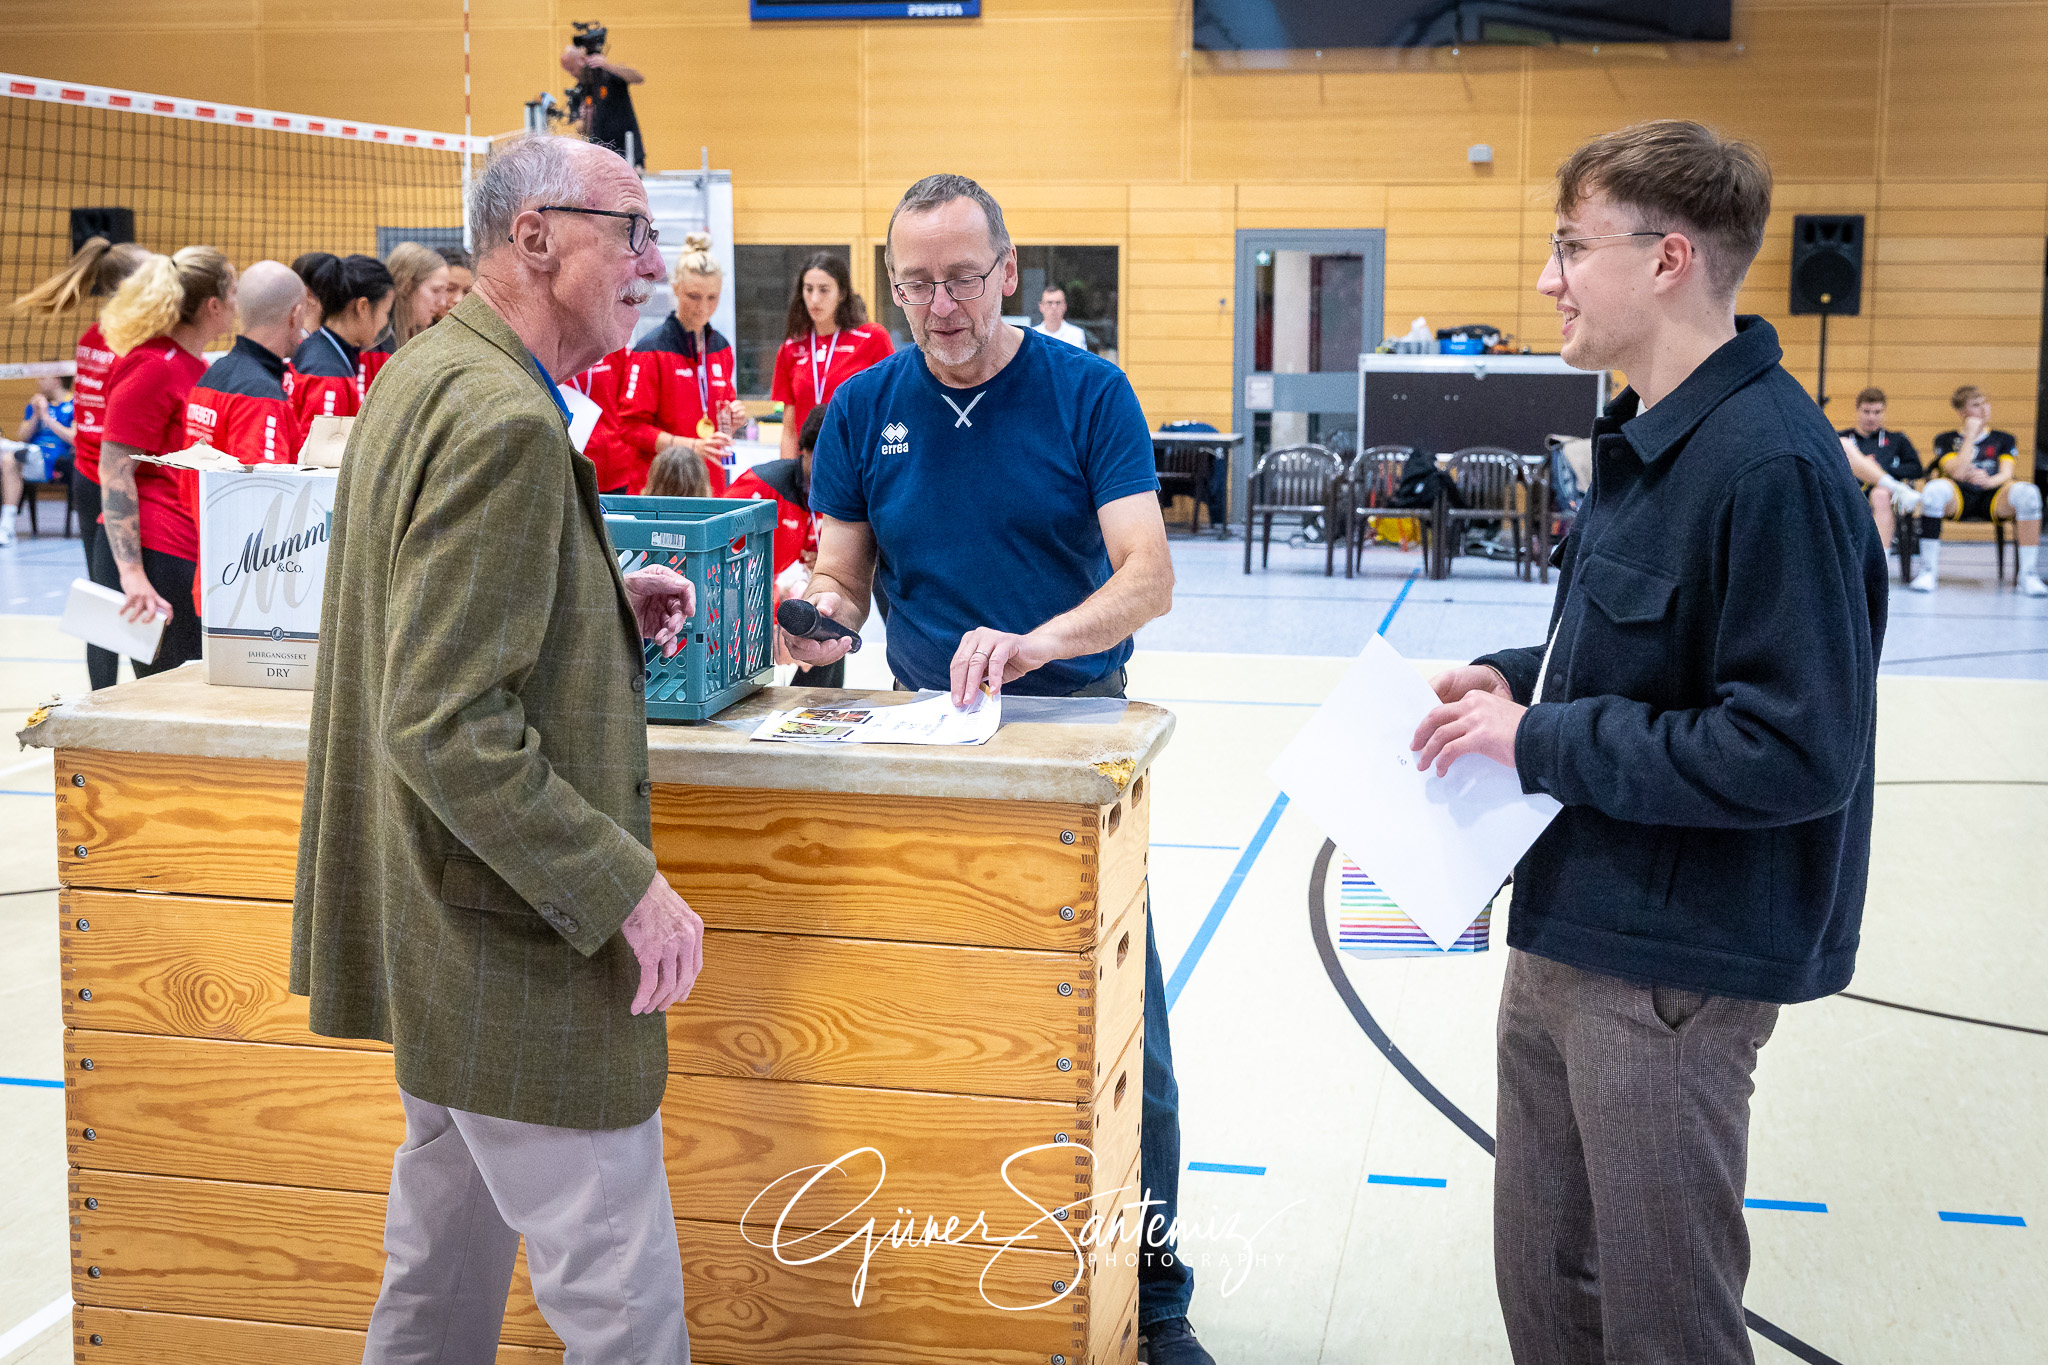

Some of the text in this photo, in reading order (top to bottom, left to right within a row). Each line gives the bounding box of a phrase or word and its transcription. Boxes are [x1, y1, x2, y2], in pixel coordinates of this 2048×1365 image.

[881, 441, 909, 455] errea
[222, 522, 328, 586] Mumm
[277, 560, 304, 574] &Co.
[248, 650, 307, 661] JAHRGANGSSEKT
[266, 667, 291, 678] DRY
